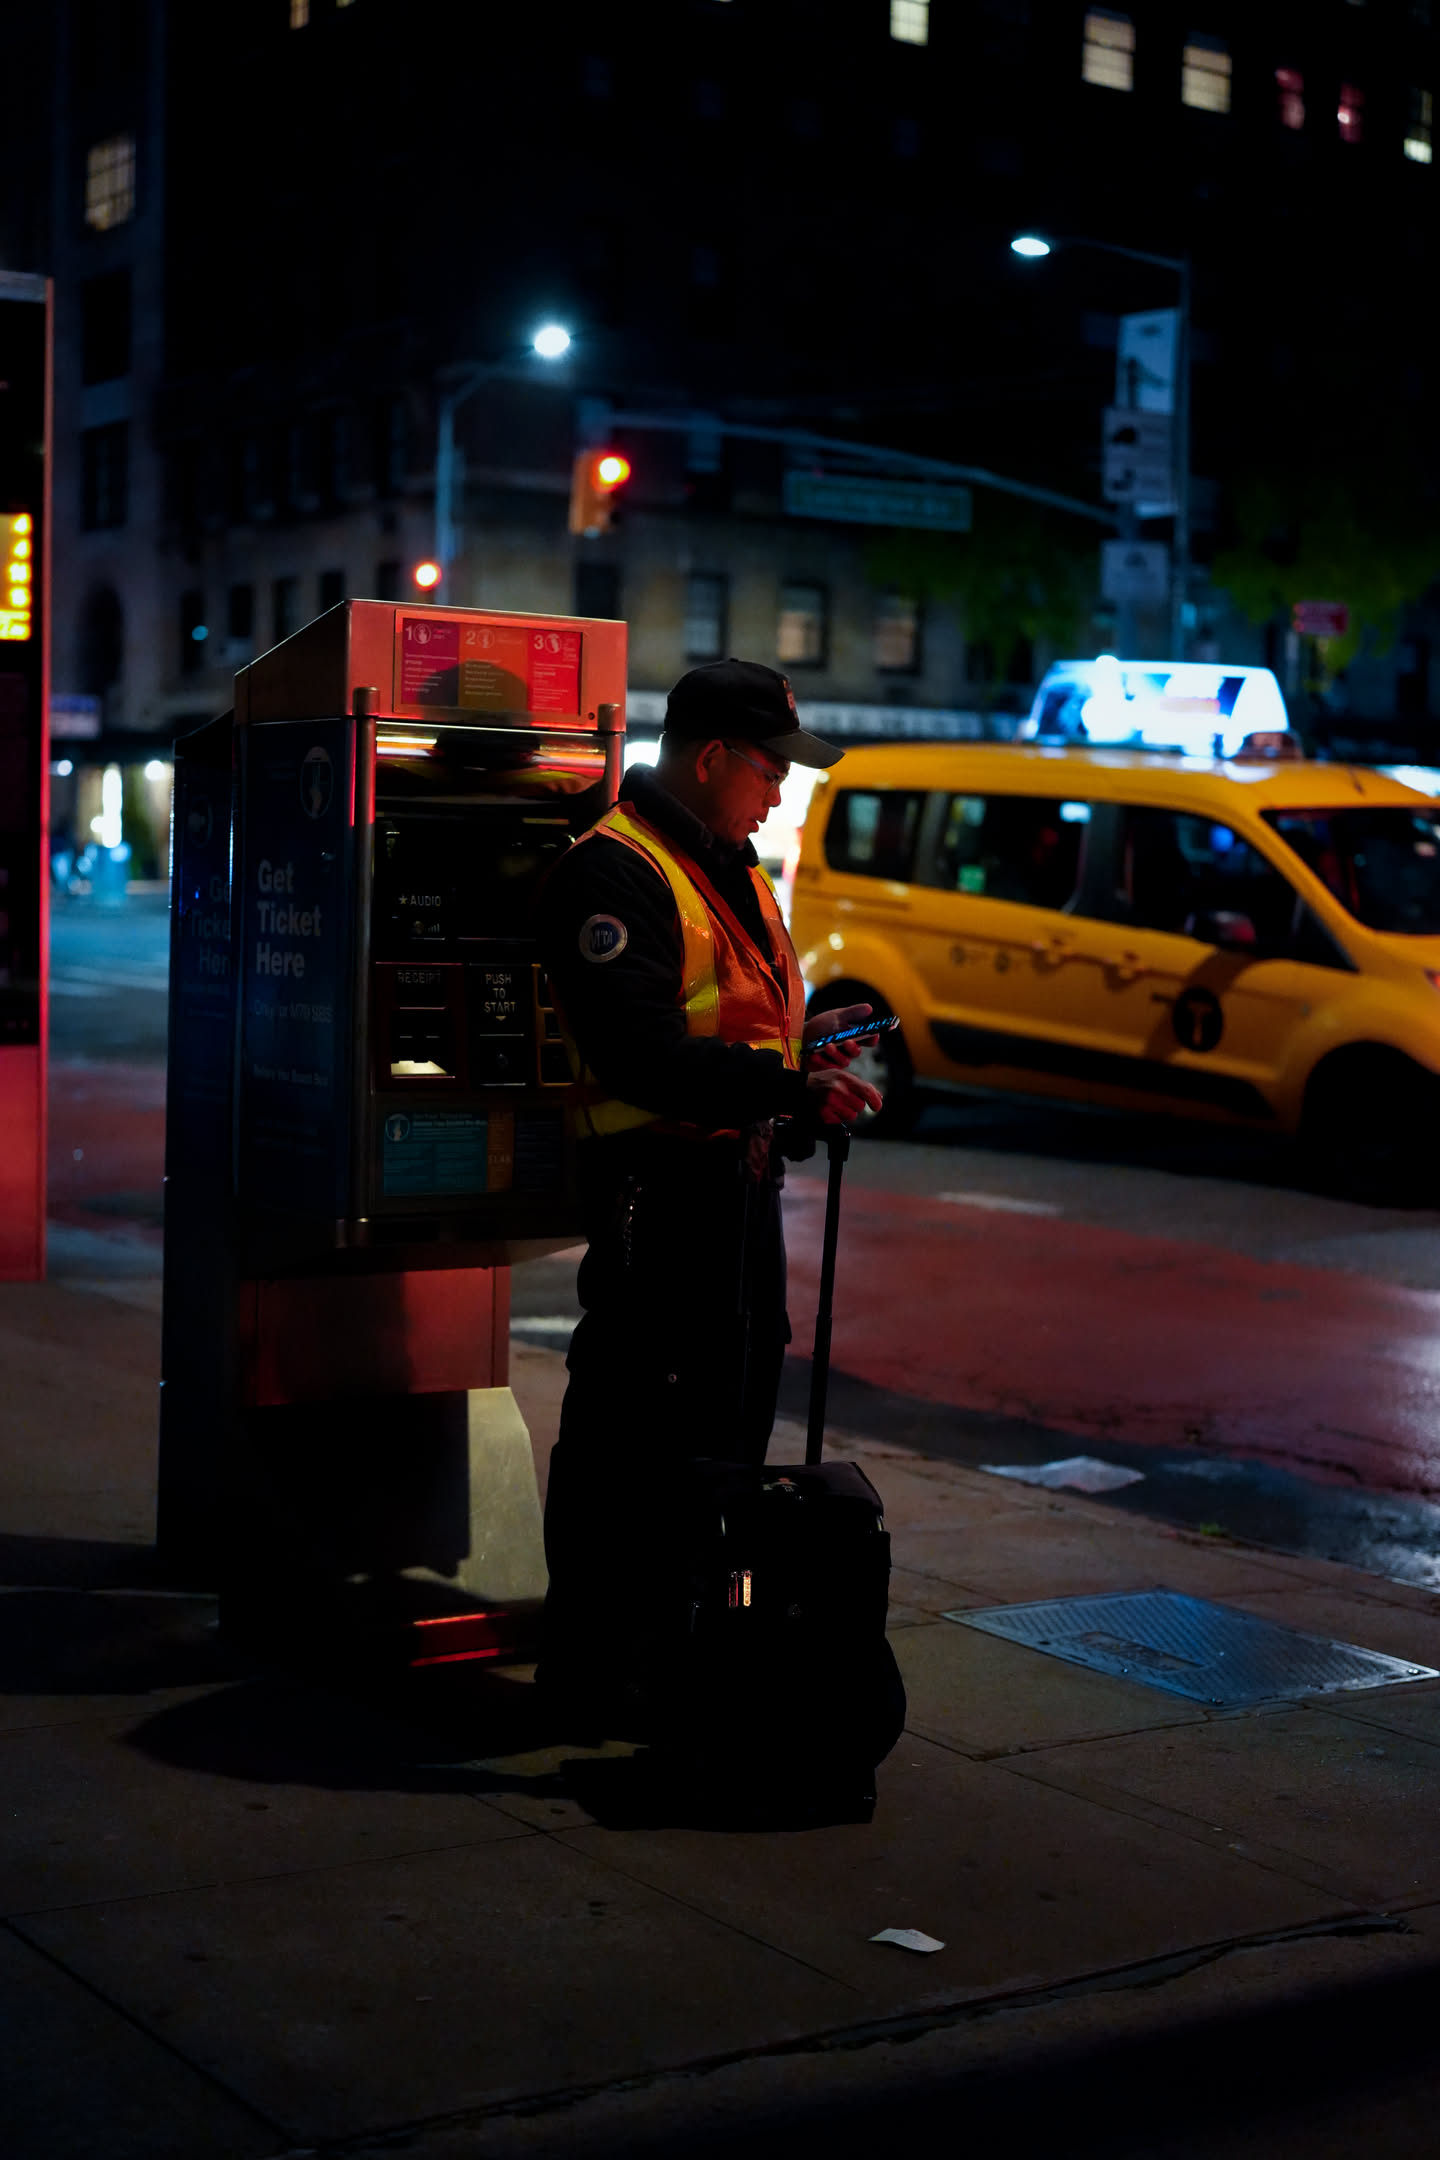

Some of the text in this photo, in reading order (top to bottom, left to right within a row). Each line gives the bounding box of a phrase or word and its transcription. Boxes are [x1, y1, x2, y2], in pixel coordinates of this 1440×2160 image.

[405, 626, 413, 641] 1
[465, 630, 476, 645] 2
[533, 634, 544, 650] 3
[257, 858, 295, 894] Get
[210, 875, 230, 903] Ge
[409, 895, 442, 907] AUDIO
[190, 909, 231, 939] Ticke
[256, 899, 323, 936] Ticket
[199, 946, 231, 977] Her
[256, 940, 305, 978] Here
[397, 971, 441, 984] RECEIPT
[485, 972, 512, 985] PUSH
[492, 987, 506, 999] TO
[484, 1001, 516, 1013] START
[1186, 1000, 1214, 1047] T
